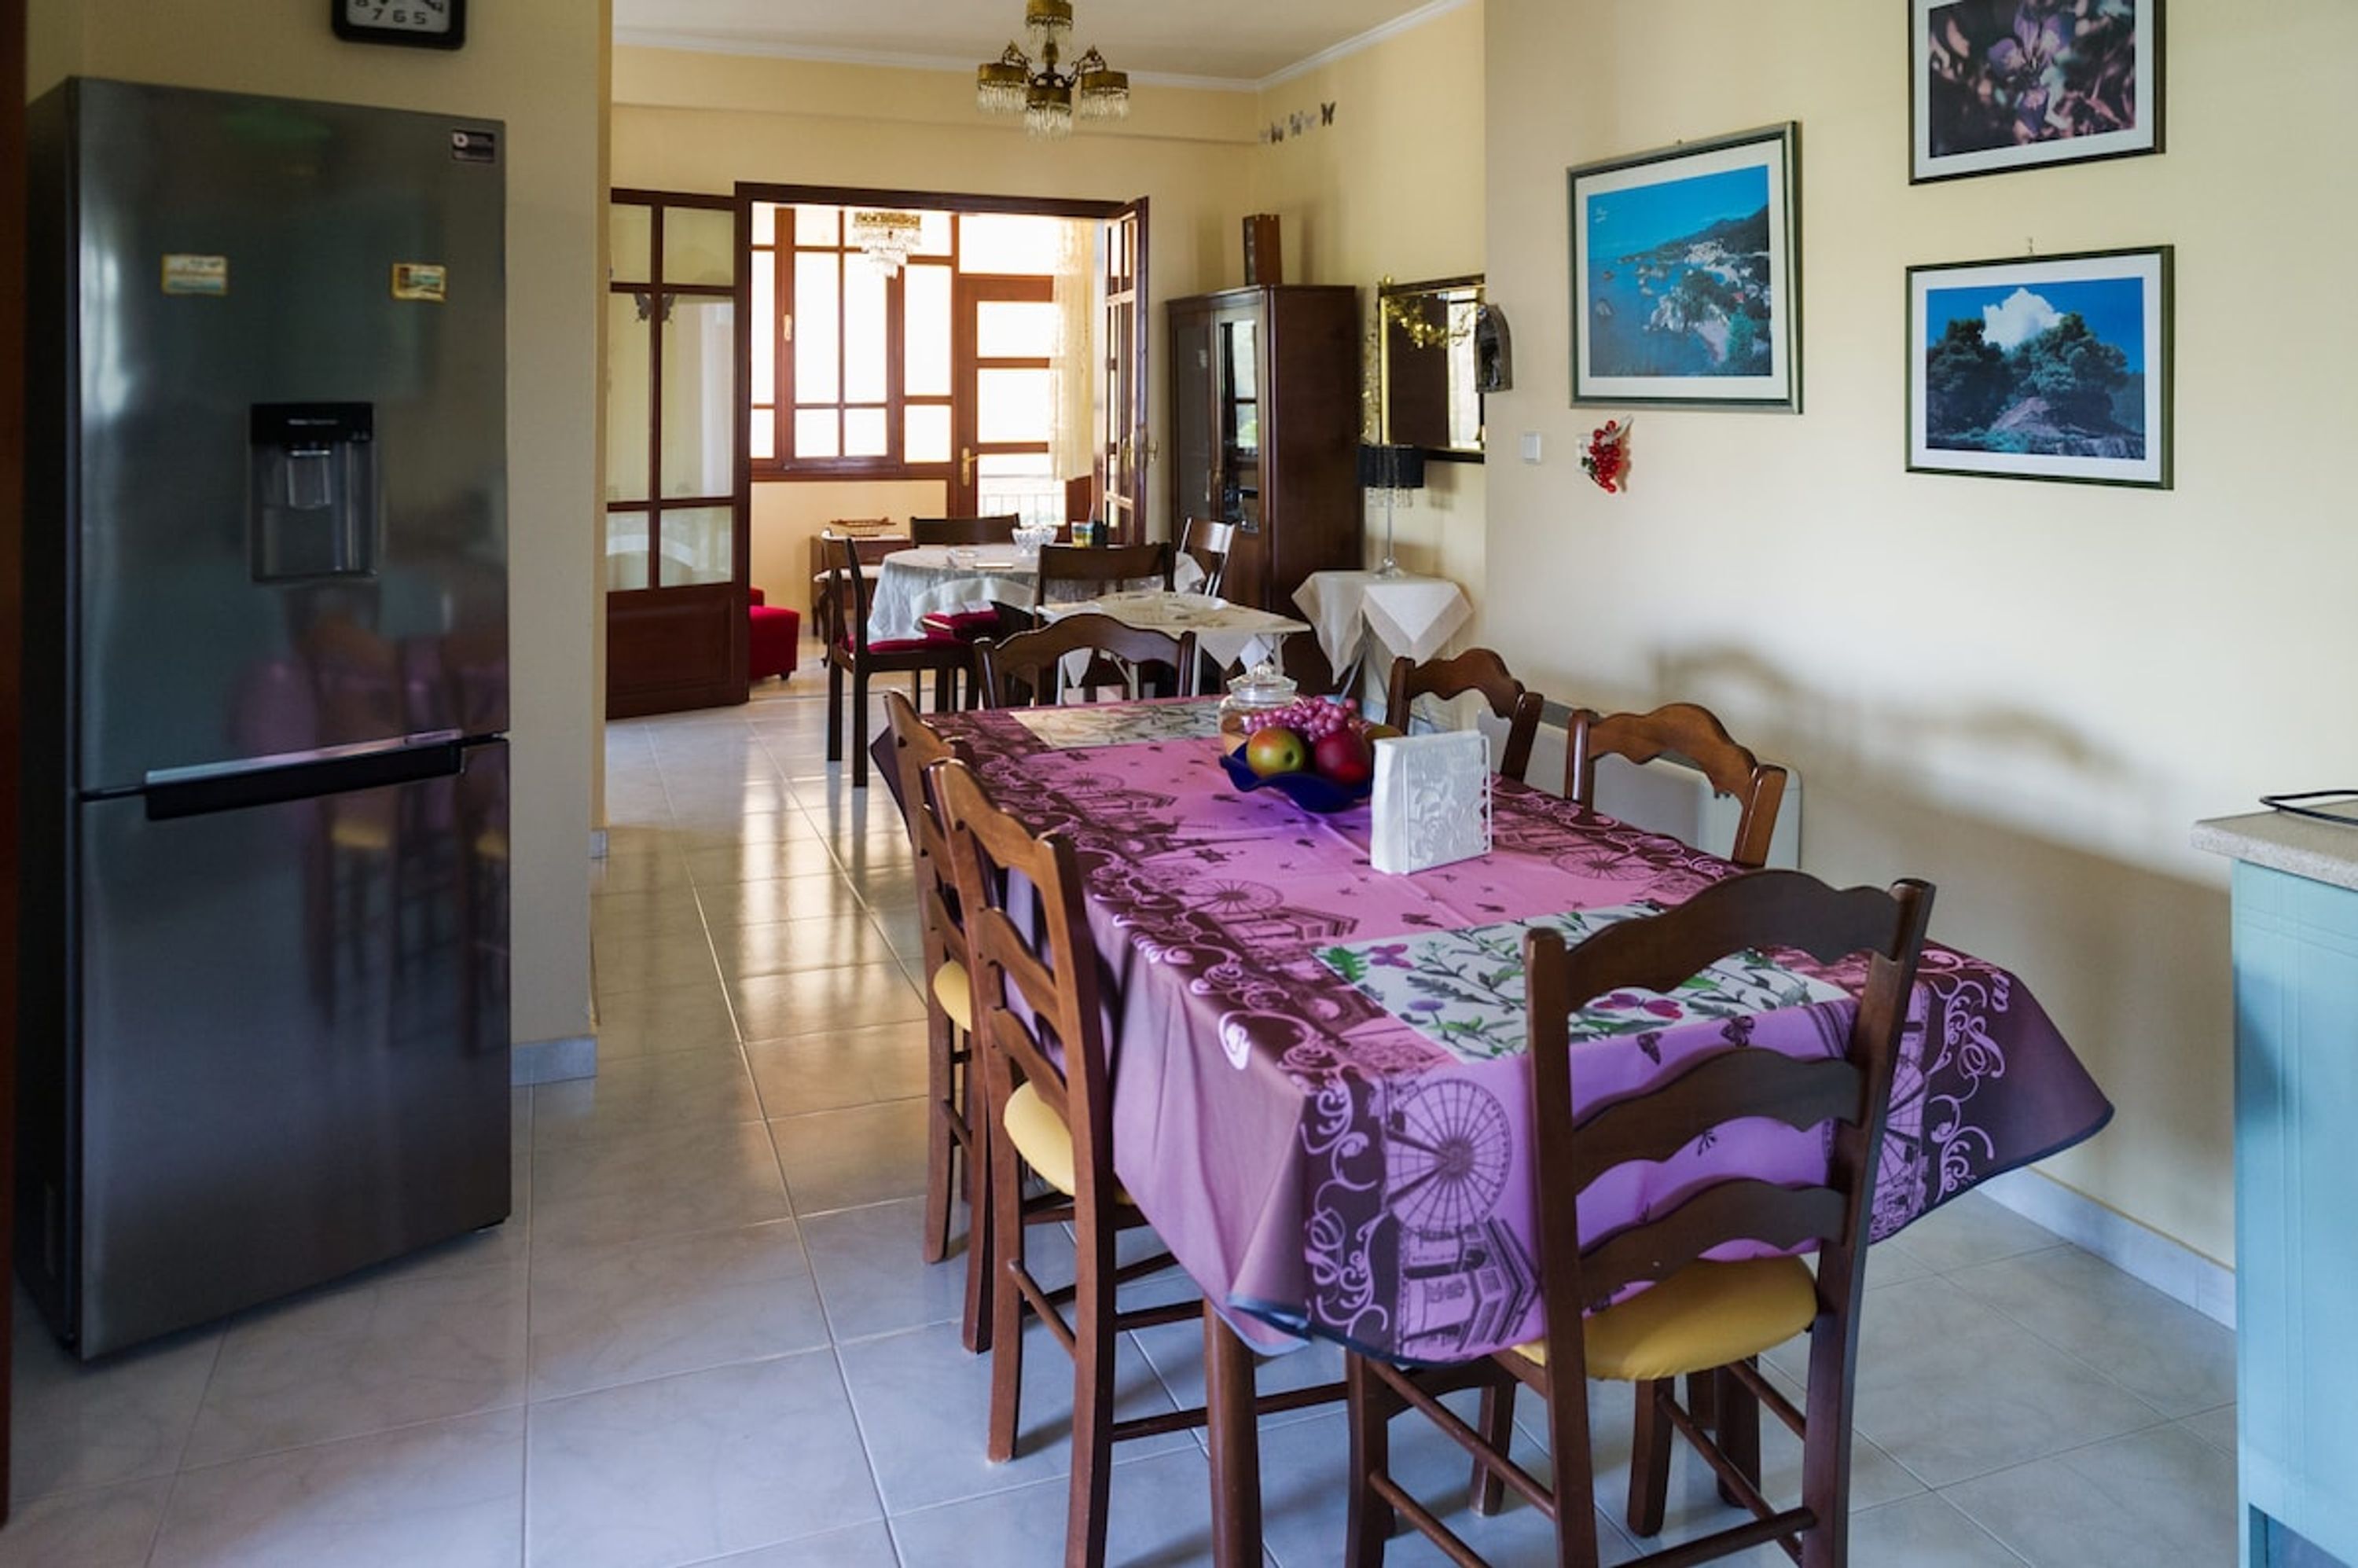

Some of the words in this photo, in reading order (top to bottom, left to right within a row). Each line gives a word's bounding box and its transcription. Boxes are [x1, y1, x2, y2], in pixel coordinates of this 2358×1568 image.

[373, 7, 384, 20] 7
[392, 9, 406, 23] 6
[413, 12, 426, 24] 5
